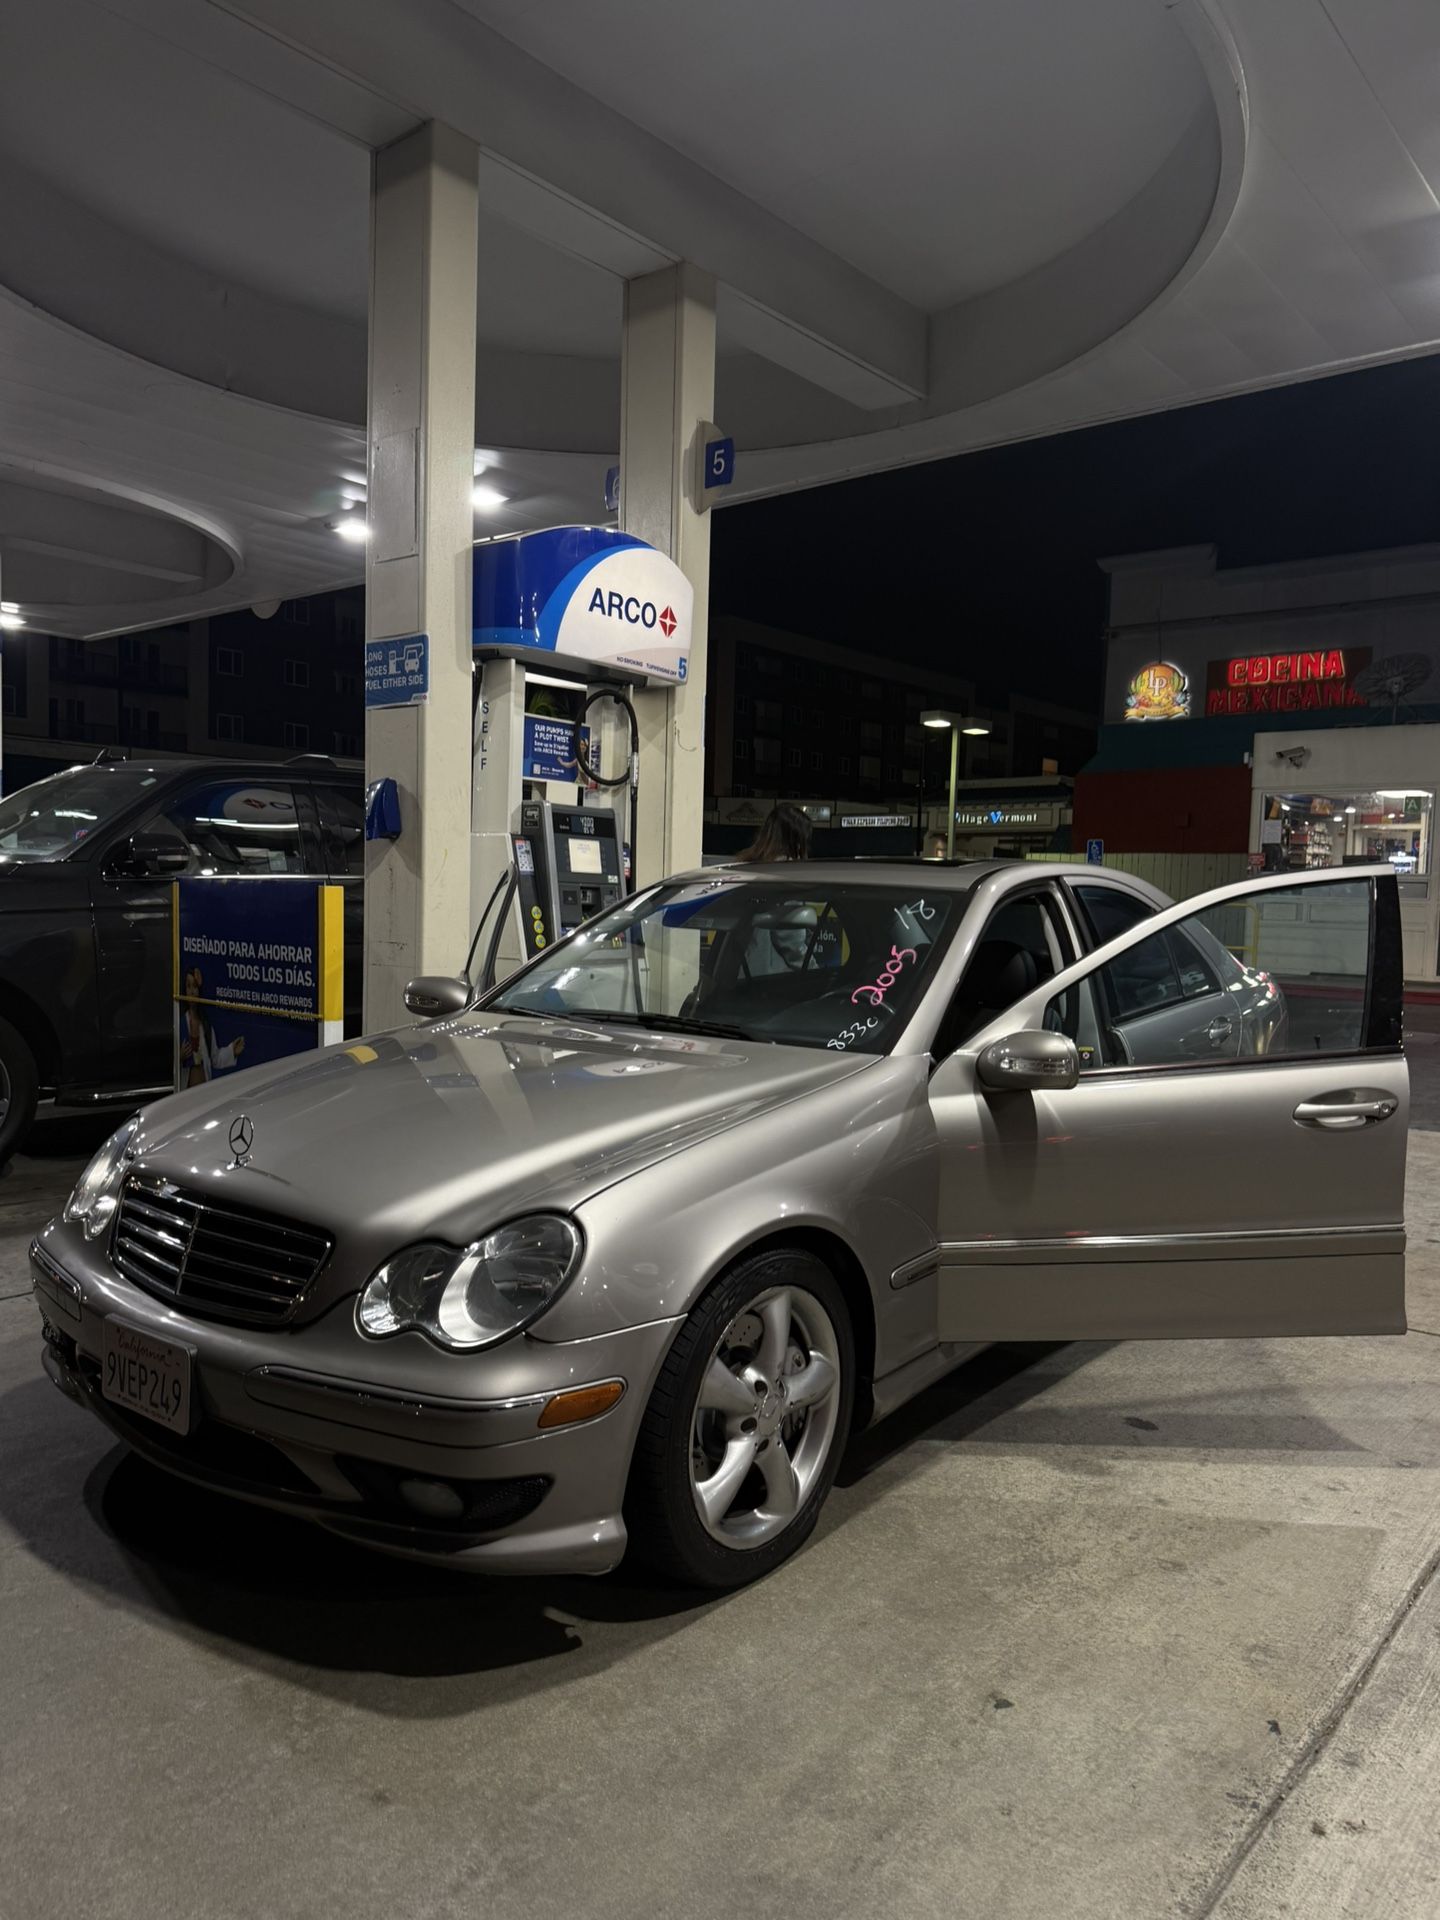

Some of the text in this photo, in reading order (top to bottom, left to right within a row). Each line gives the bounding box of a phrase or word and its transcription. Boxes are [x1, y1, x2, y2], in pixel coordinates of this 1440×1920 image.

[712, 448, 726, 476] 5
[588, 587, 657, 629] ARCO
[383, 676, 408, 689] EITHER
[408, 674, 424, 686] SIDE
[678, 656, 688, 680] 5
[1227, 649, 1345, 686] COCINA
[1206, 681, 1368, 716] MEXICANA
[481, 701, 489, 770] SELF
[990, 810, 1038, 825] Vermont
[184, 935, 313, 964] DISEÑADO PARA AHORRAR
[226, 962, 316, 988] TODOS LOS DÍAS.
[851, 944, 917, 1006] 2005
[251, 991, 261, 1002] EN
[261, 992, 279, 1005] ARCO
[279, 994, 313, 1009] REWARDS
[107, 1351, 181, 1417] 9VEP249
